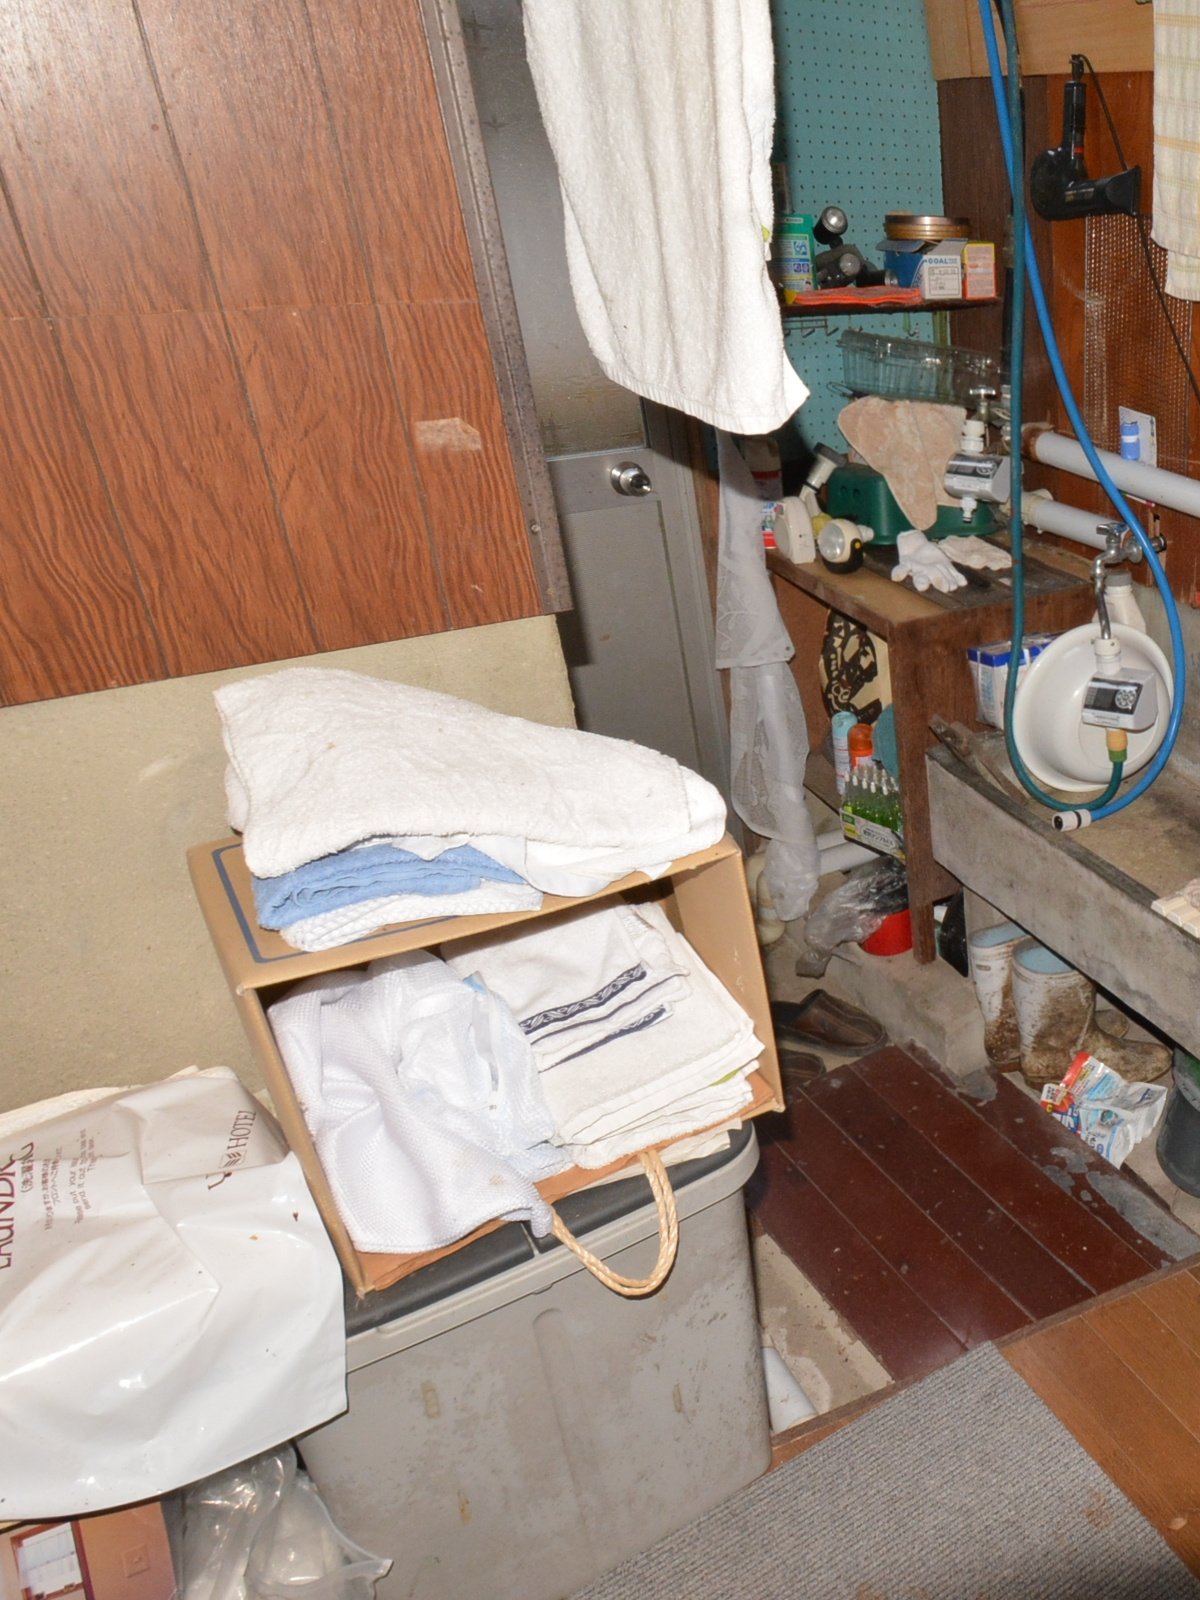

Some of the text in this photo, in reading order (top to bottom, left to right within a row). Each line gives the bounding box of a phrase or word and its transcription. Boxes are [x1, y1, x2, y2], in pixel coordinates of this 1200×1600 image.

[226, 1110, 257, 1151] HOTEL
[69, 1171, 77, 1187] your
[70, 1190, 79, 1204] put
